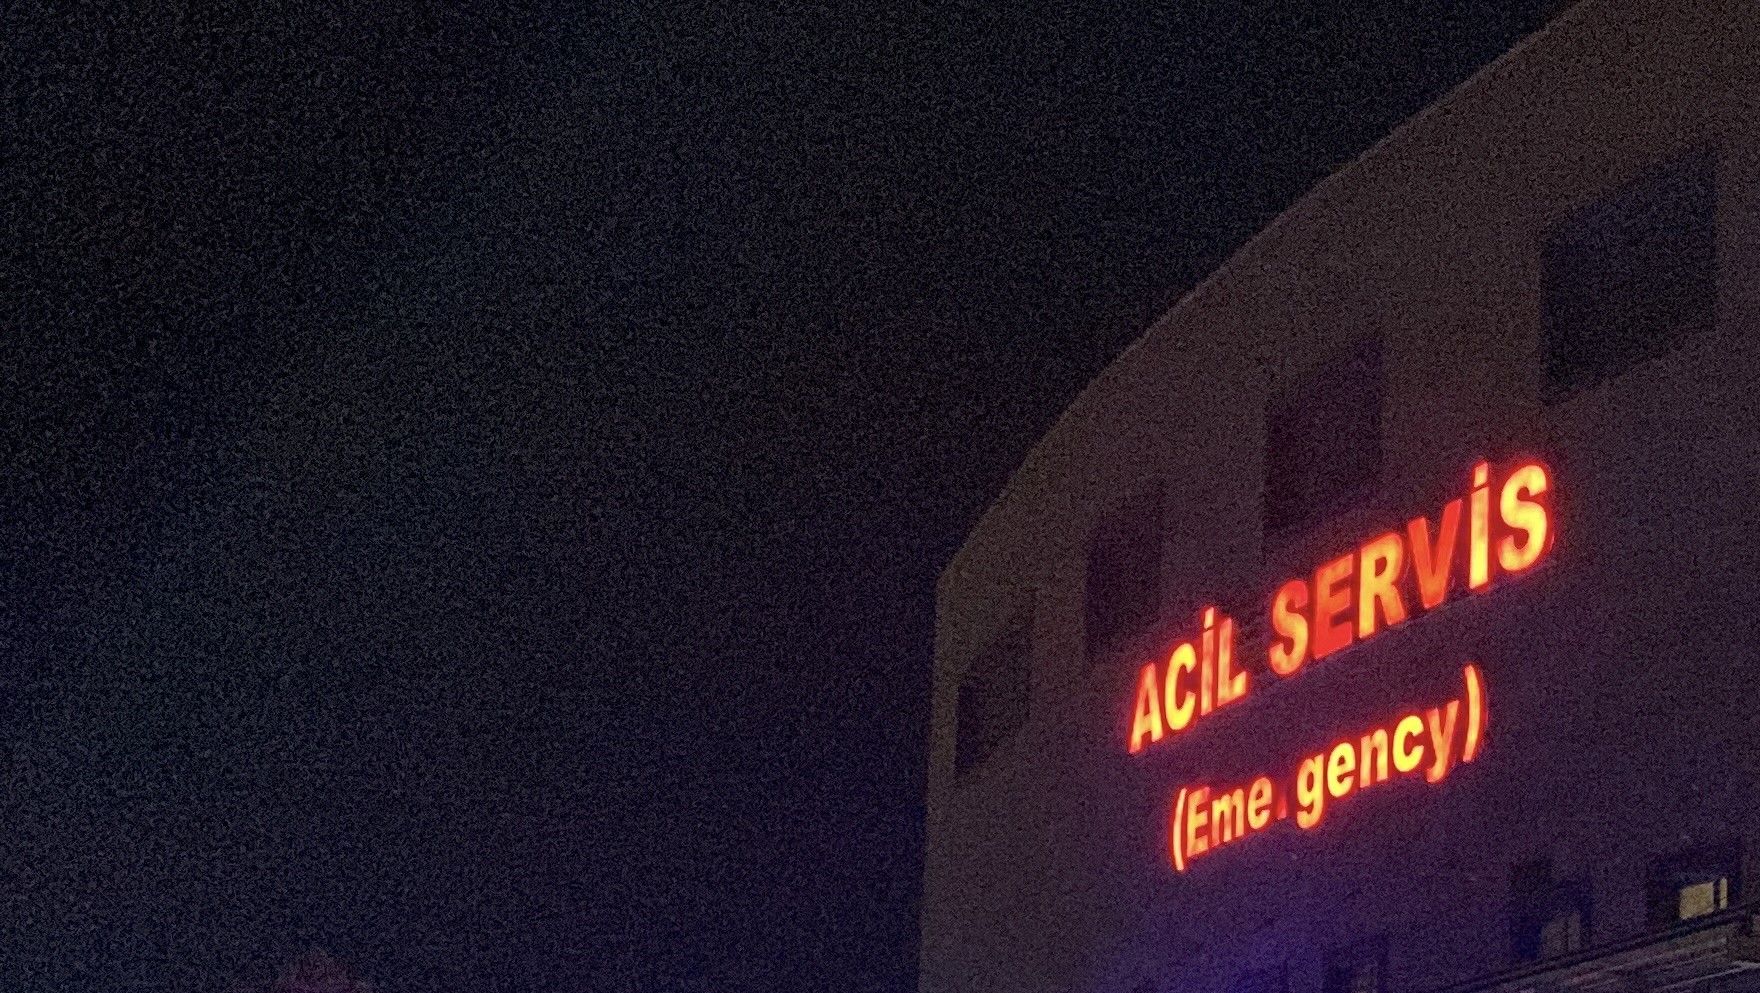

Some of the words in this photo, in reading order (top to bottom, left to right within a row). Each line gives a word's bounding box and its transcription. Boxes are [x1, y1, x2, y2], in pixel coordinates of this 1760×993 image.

[1127, 606, 1247, 754] ACİL
[1268, 461, 1549, 677] SERVİS
[1171, 664, 1480, 871] (Emegency)
